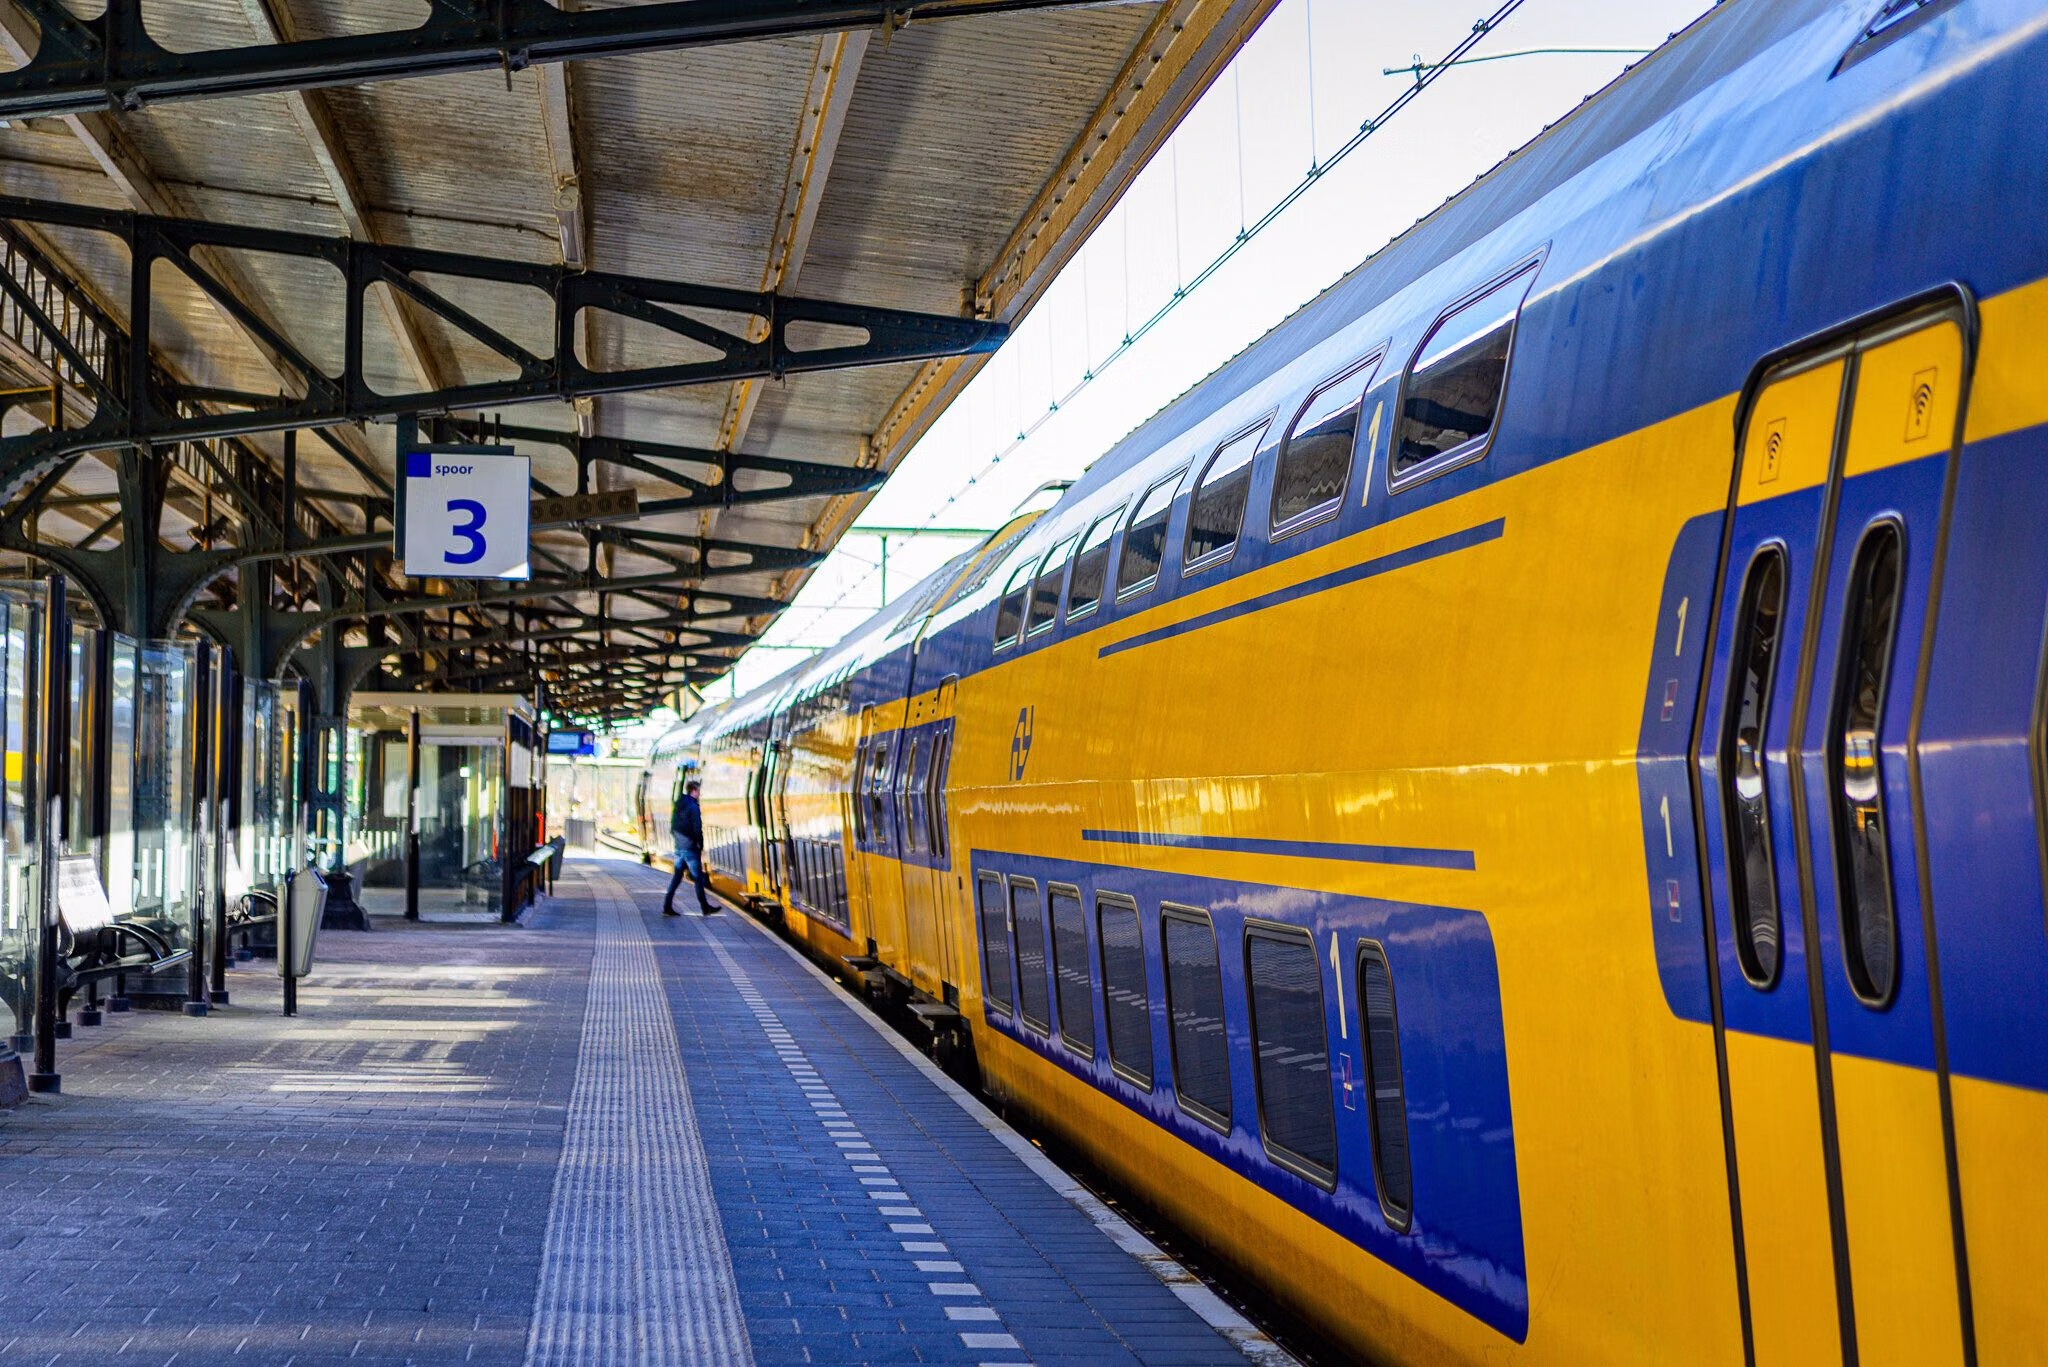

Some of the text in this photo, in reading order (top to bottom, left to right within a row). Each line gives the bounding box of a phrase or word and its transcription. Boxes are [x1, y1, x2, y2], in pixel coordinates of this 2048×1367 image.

[435, 464, 474, 475] spoor
[1362, 401, 1383, 507] 1
[444, 499, 487, 564] 3
[1675, 597, 1689, 657] 1
[1660, 796, 1673, 857] 1
[1329, 931, 1347, 1039] 1
